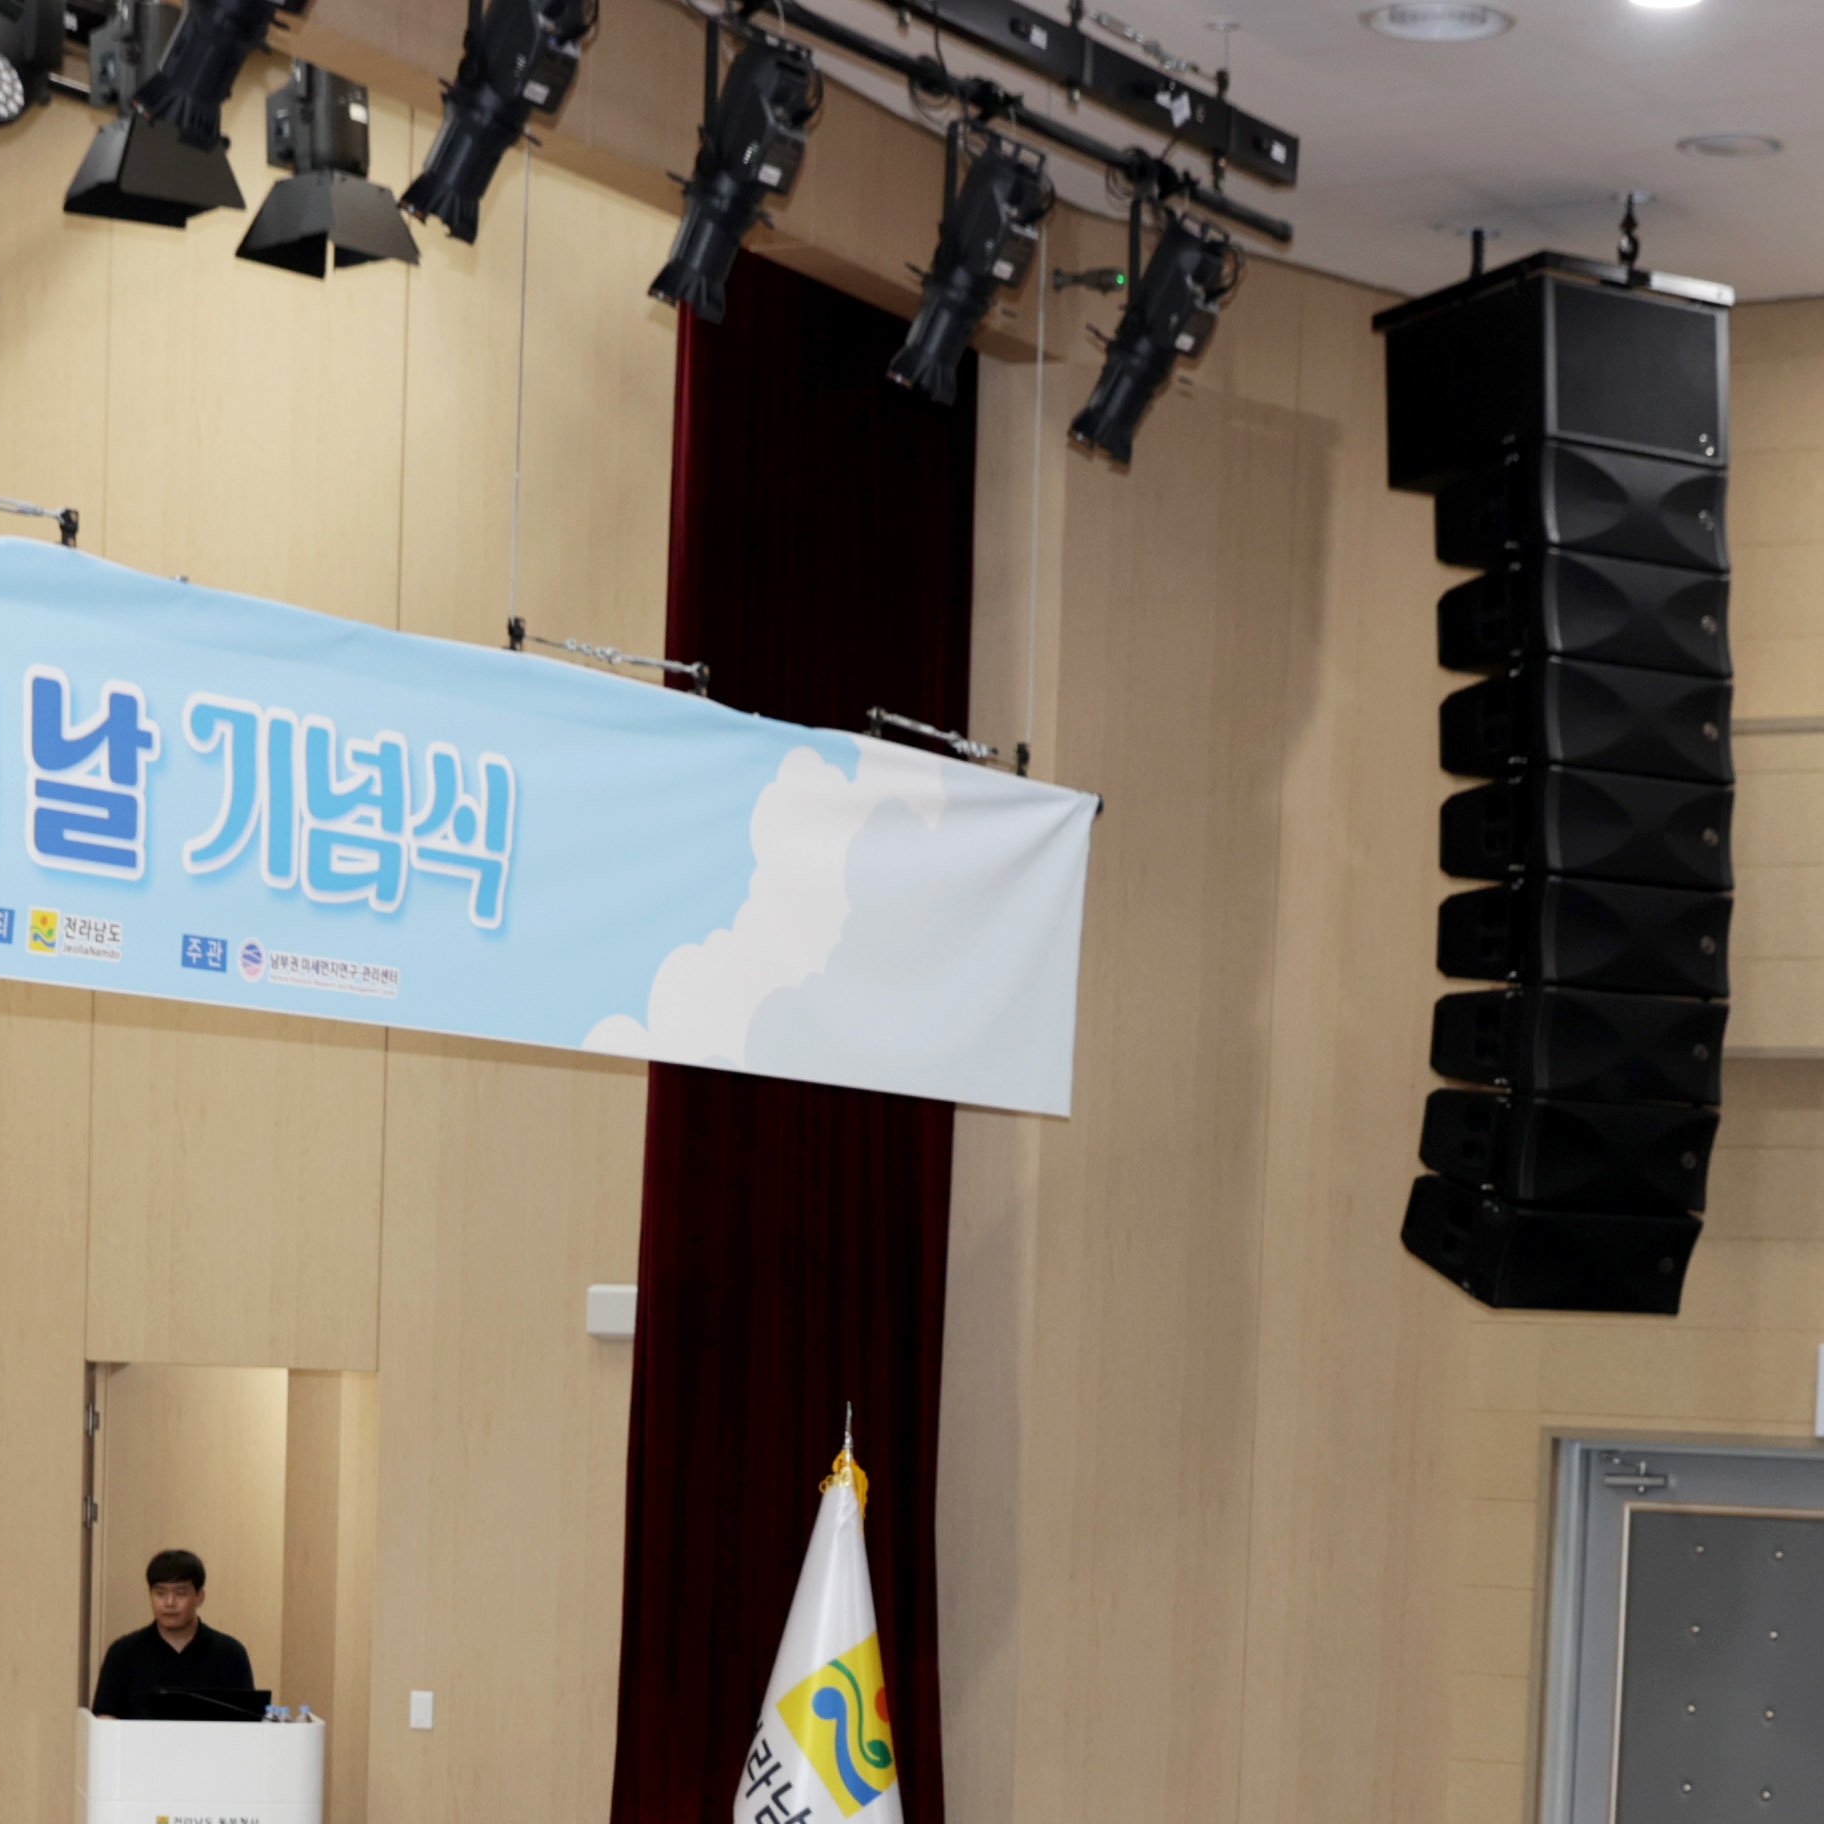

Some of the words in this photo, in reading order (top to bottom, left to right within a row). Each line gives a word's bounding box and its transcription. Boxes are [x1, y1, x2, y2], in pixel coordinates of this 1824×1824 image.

[30, 677, 155, 872] 날
[188, 702, 513, 921] 기념식
[63, 915, 122, 944] 전라남도
[186, 936, 224, 968] 주관
[270, 953, 300, 973] 남부권
